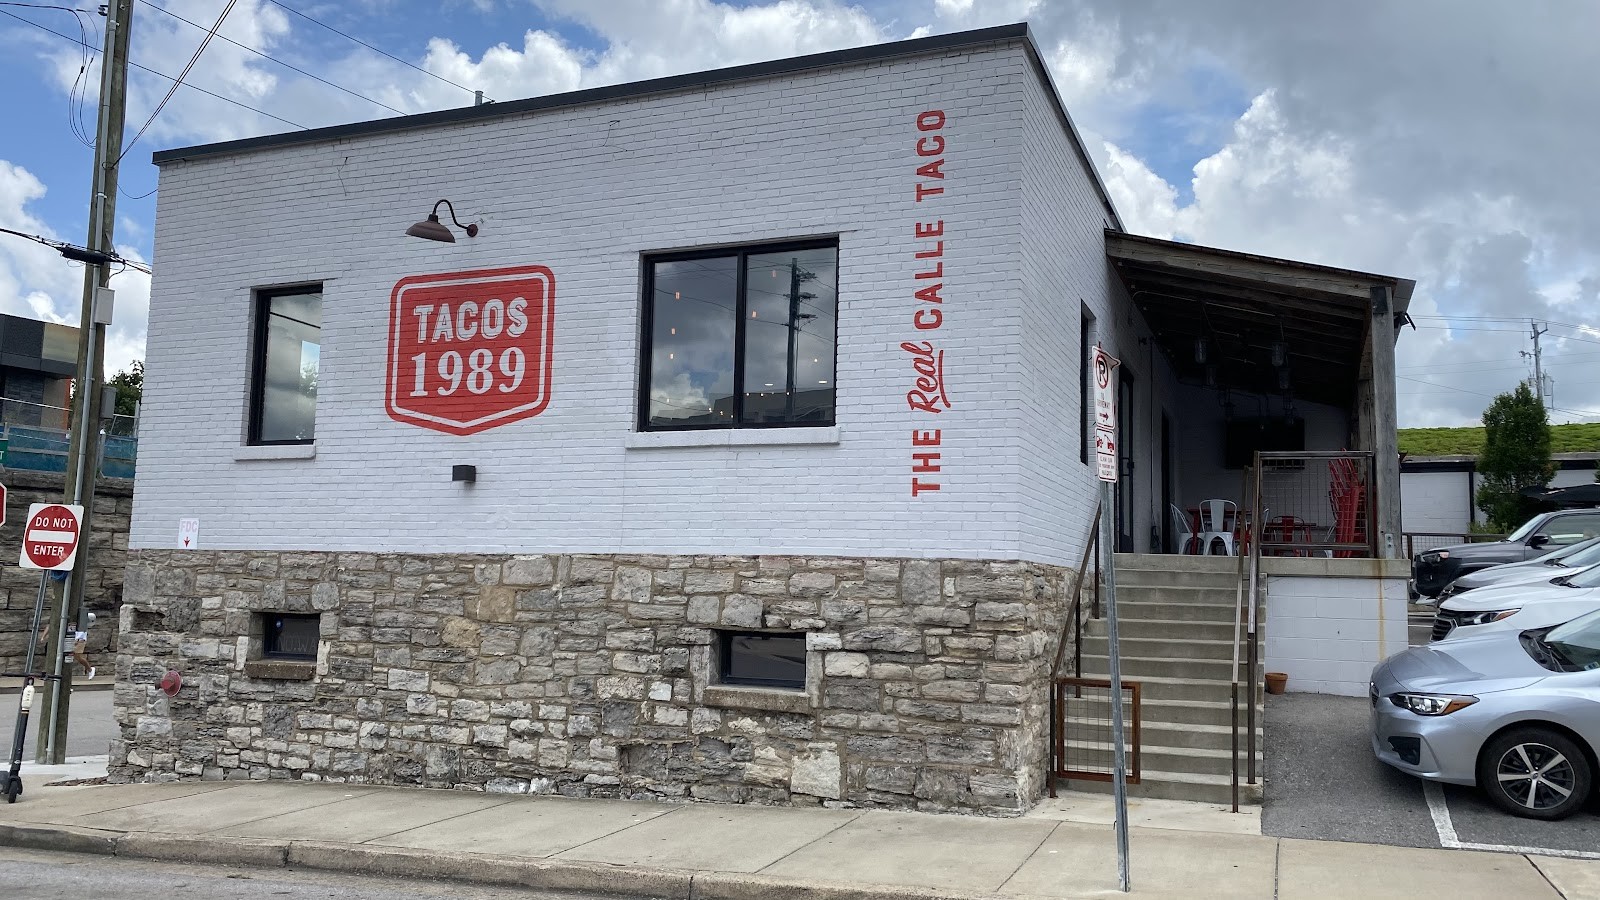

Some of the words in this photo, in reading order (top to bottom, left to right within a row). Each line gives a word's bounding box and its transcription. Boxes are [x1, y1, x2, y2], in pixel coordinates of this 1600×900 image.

[916, 109, 946, 202] TACO
[914, 220, 944, 330] CALLE
[413, 297, 529, 344] TACOS
[409, 347, 526, 397] 1989
[900, 341, 944, 414] Real
[912, 429, 941, 497] THE
[35, 516, 50, 528] DO
[52, 517, 74, 529] NOT
[180, 520, 199, 533] FDC
[33, 544, 65, 557] ENTER
